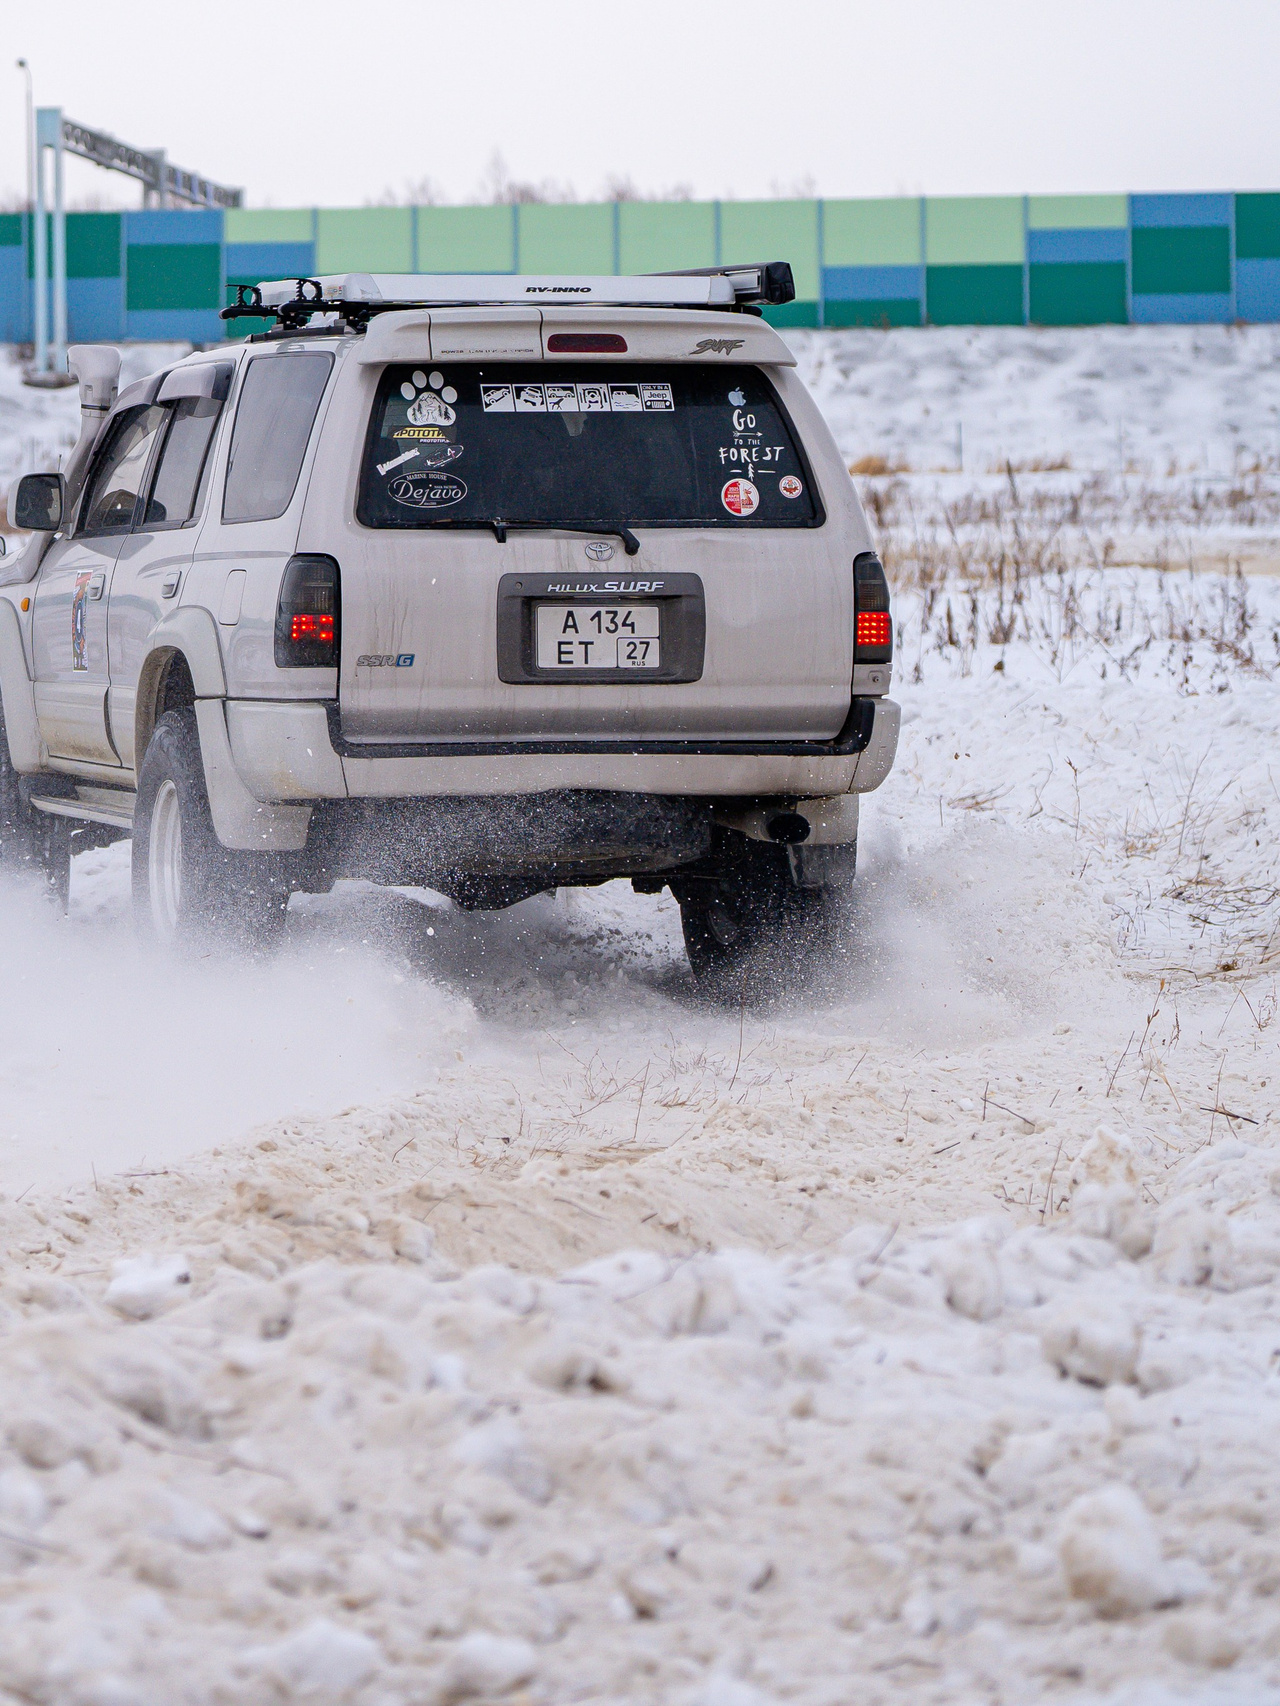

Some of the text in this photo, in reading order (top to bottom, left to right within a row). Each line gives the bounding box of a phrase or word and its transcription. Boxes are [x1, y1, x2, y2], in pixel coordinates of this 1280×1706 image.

[689, 339, 745, 355] SURF
[719, 446, 785, 464] FOREST
[547, 581, 664, 593] HILUX SURF
[562, 610, 636, 634] A 134
[557, 640, 594, 665] ET
[626, 641, 650, 660] 27
